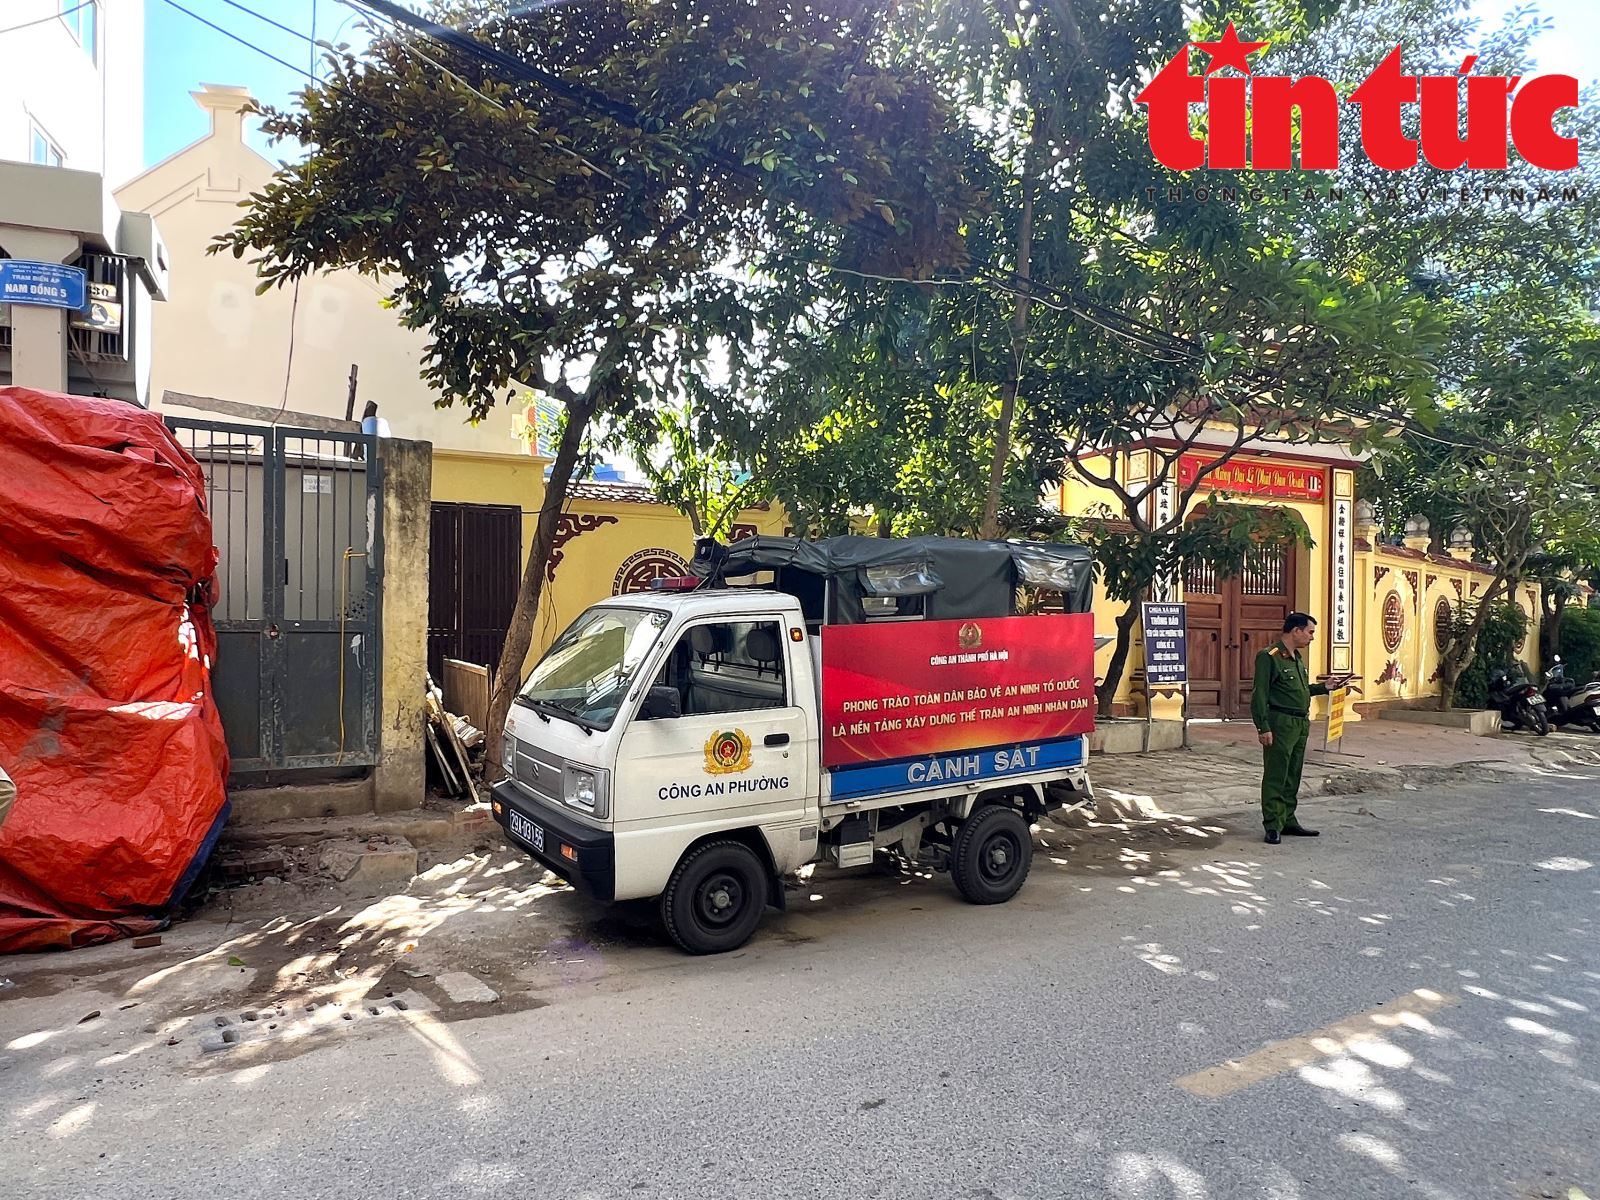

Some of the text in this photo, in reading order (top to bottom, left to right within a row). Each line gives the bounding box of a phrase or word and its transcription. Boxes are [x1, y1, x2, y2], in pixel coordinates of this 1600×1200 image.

[5, 283, 28, 293] NAM
[60, 289, 67, 298] 5
[1150, 615, 1178, 625] THÔNG BÁO
[930, 649, 1009, 666] CÔNG AN THÀNH PHỐ HÀ NỘI
[843, 699, 878, 713] PHONG
[882, 695, 910, 709] TRÀO
[914, 692, 941, 707] TOÀN
[944, 689, 965, 703] DÂN
[967, 685, 987, 701] BẢO
[1004, 684, 1018, 696] AN
[1020, 682, 1040, 695] NINH
[1043, 679, 1054, 691] TỔ
[1056, 677, 1080, 691] QUỐC
[832, 722, 846, 737] LÀ
[850, 719, 870, 735] NỀN
[874, 716, 902, 733] TẢNG
[905, 714, 926, 729] XÂY
[959, 706, 976, 722] THẾ
[1007, 704, 1020, 716] AN
[1022, 703, 1042, 715] NINH
[1045, 699, 1068, 712] NHÂN
[1070, 697, 1089, 710] DÂN
[907, 744, 1041, 784] CẢNH SÁT
[658, 775, 789, 800] CÔNG AN PHƯỜNG
